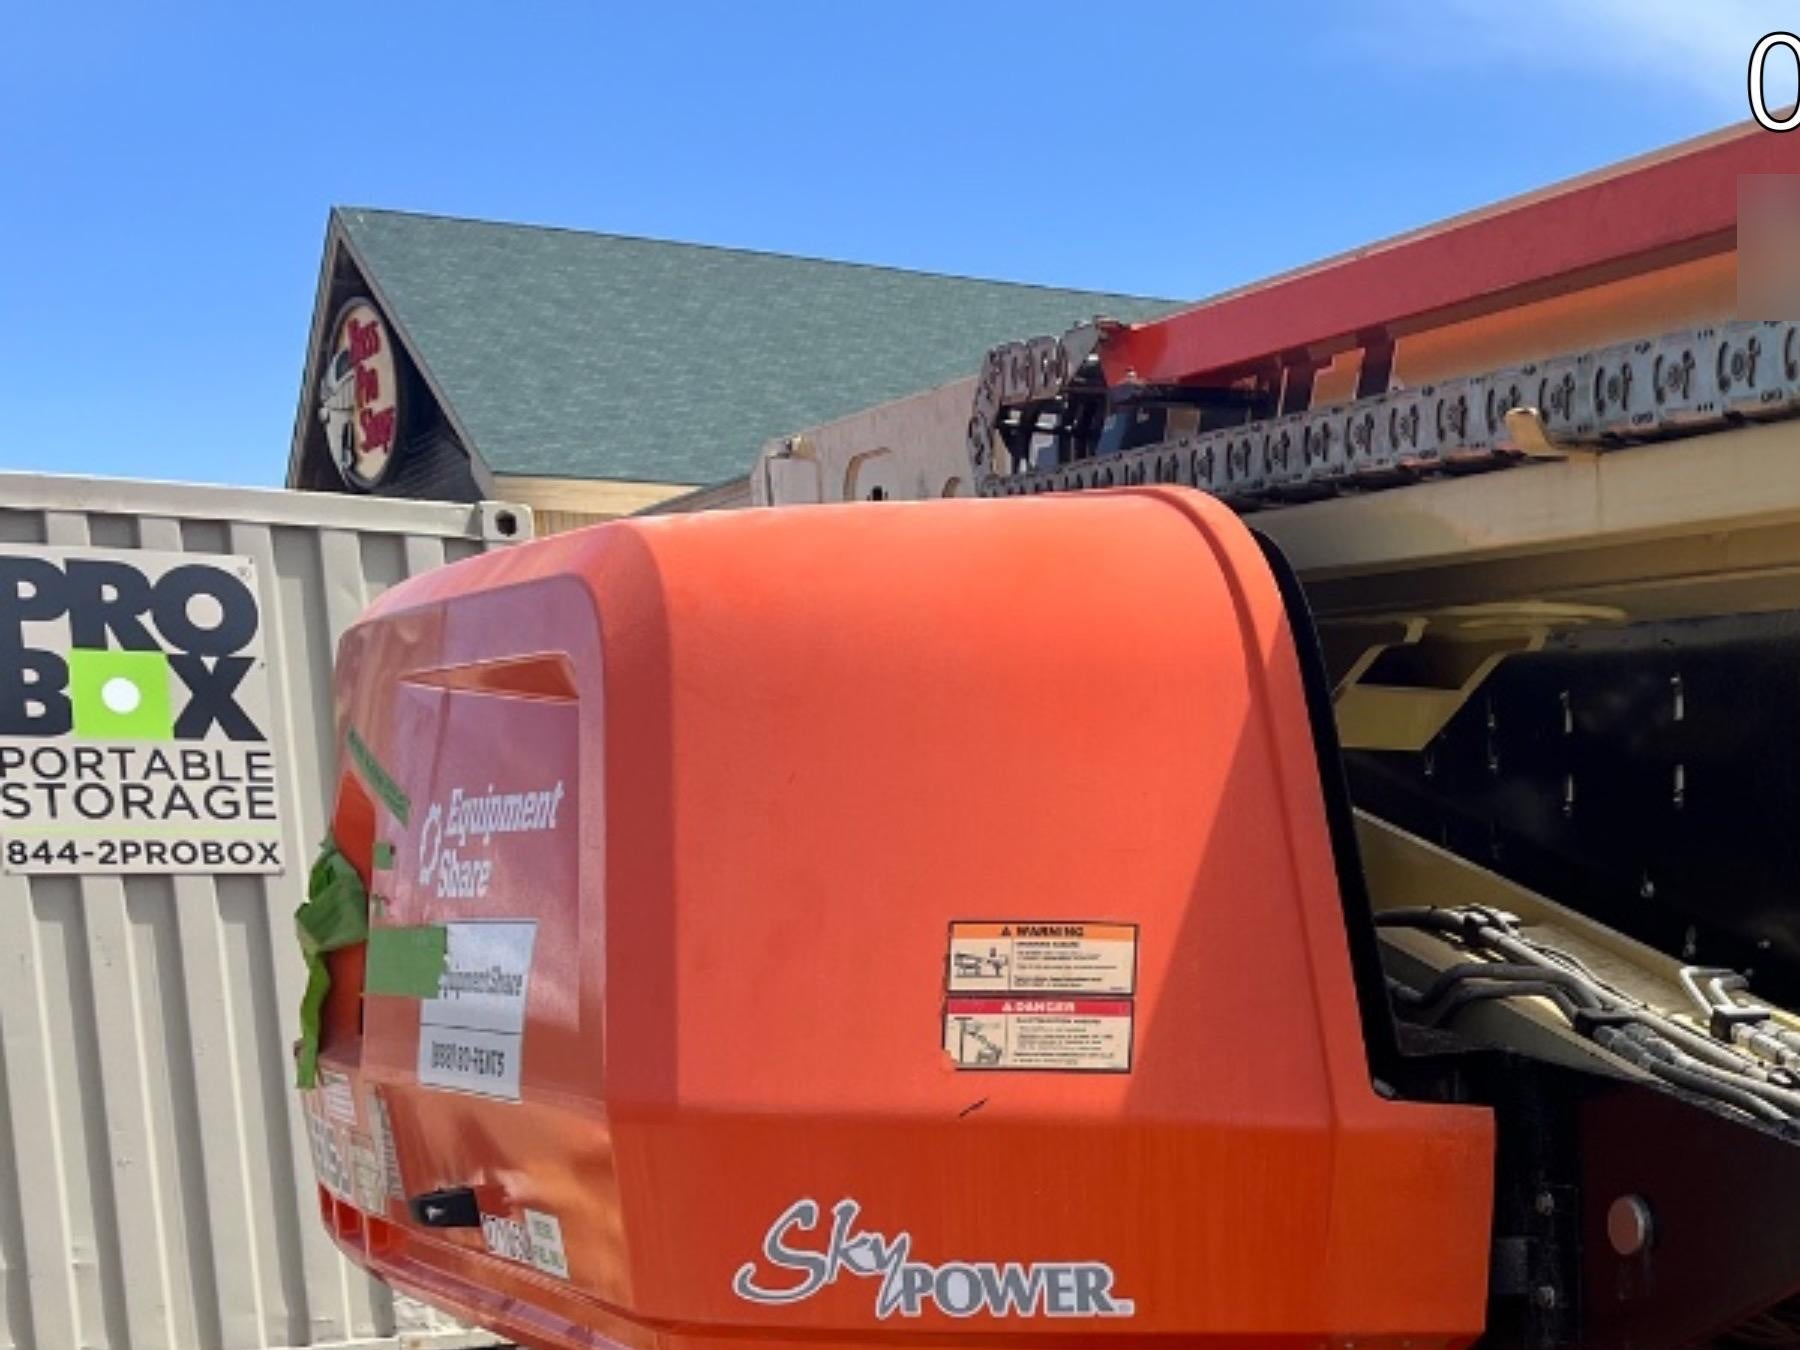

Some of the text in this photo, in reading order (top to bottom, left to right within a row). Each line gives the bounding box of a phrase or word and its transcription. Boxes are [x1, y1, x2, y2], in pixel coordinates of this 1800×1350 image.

[0, 556, 259, 656] PRO
[0, 648, 268, 741] BOX
[0, 747, 273, 781] PORTABLE
[2, 782, 276, 820] STORAGE
[444, 779, 564, 848] Equipment
[7, 840, 281, 866] 844-2PROBOX
[436, 848, 493, 899] Share
